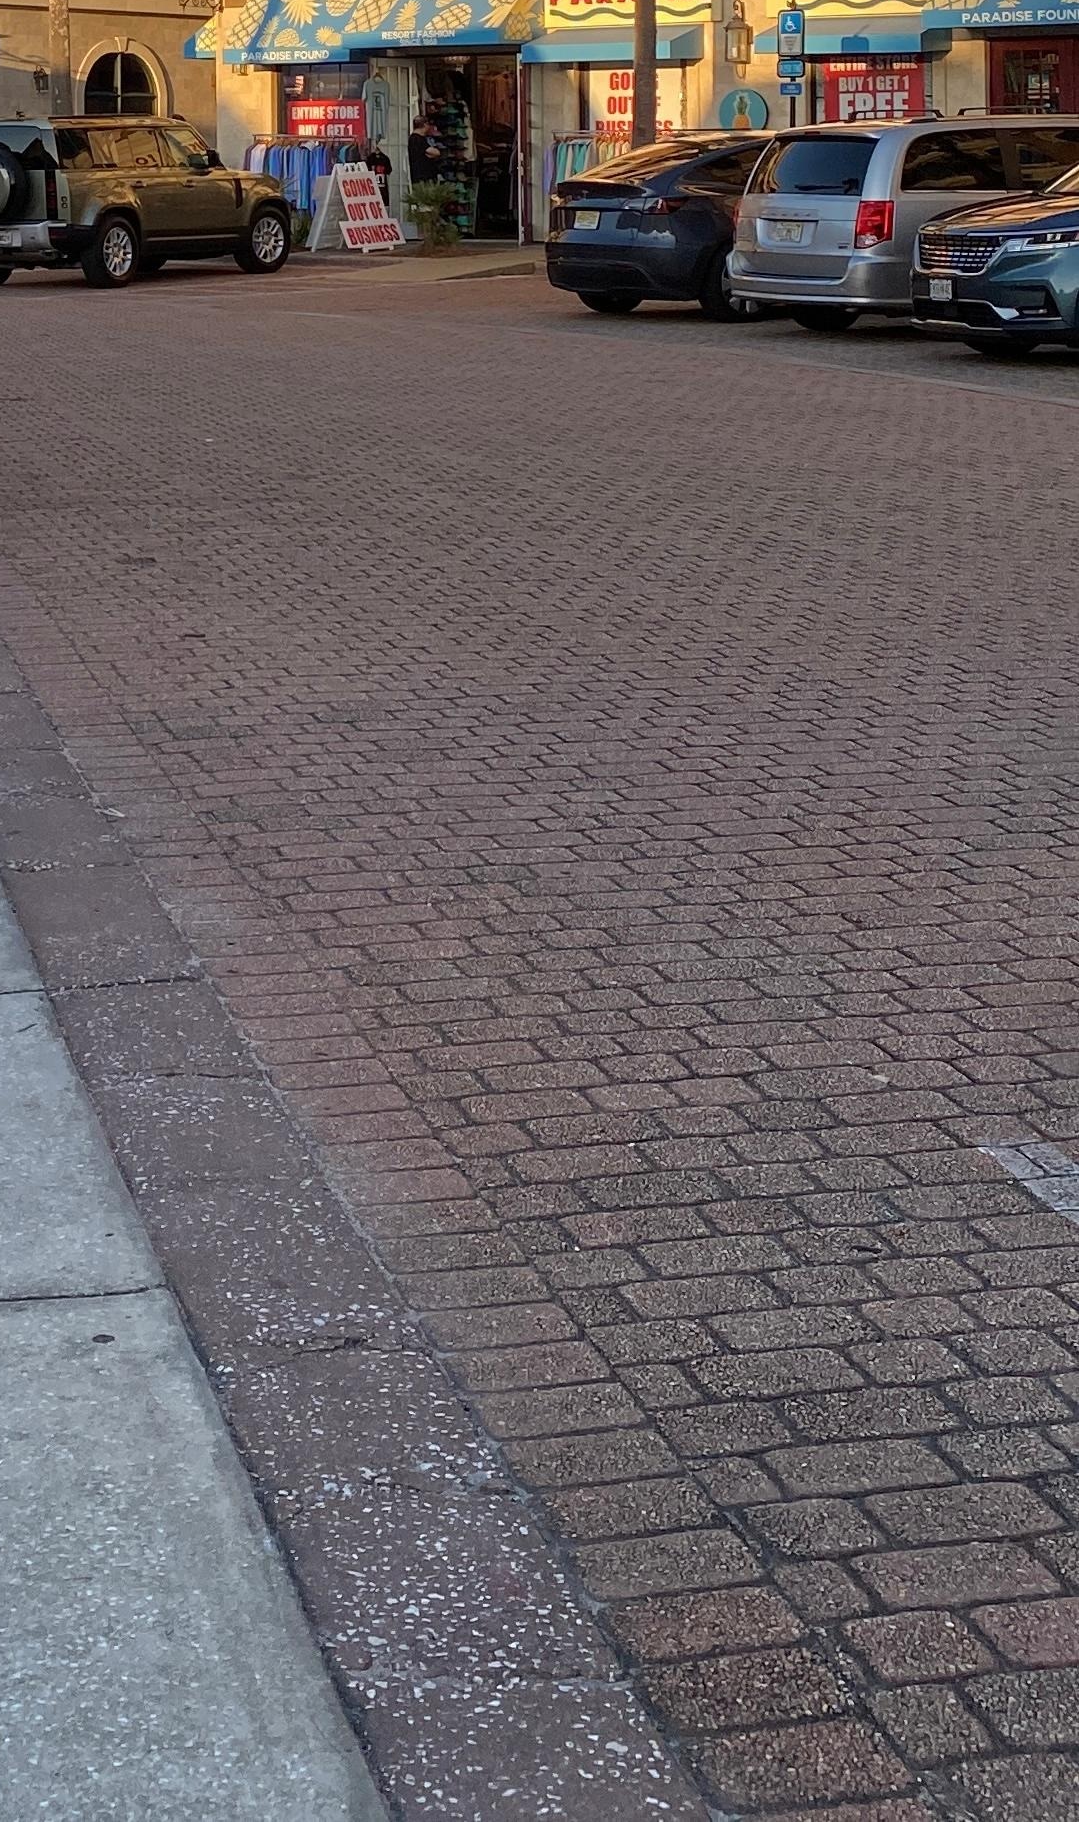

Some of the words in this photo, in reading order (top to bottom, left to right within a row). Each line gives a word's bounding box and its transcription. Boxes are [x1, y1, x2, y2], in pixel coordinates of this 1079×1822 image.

[961, 10, 1033, 24] PARADISE
[1037, 8, 1079, 21] FOUN
[381, 30, 415, 40] RESORT
[416, 29, 456, 39] FASHION
[241, 50, 292, 61] PARADISE
[293, 49, 330, 60] FOUND
[838, 76, 864, 92] BUY
[866, 76, 873, 91] 1
[876, 75, 900, 91] GET
[902, 75, 910, 91] 1
[291, 106, 326, 120] ENTIRE
[326, 105, 360, 119] STORE
[838, 92, 909, 120] FREE
[298, 124, 319, 136] BUY
[319, 124, 326, 136] 1
[326, 124, 345, 136] GET
[346, 124, 353, 136] 1
[342, 177, 376, 198] GOING
[347, 202, 370, 222] OUT
[369, 201, 384, 220] OF
[346, 223, 400, 246] BUSINESS
